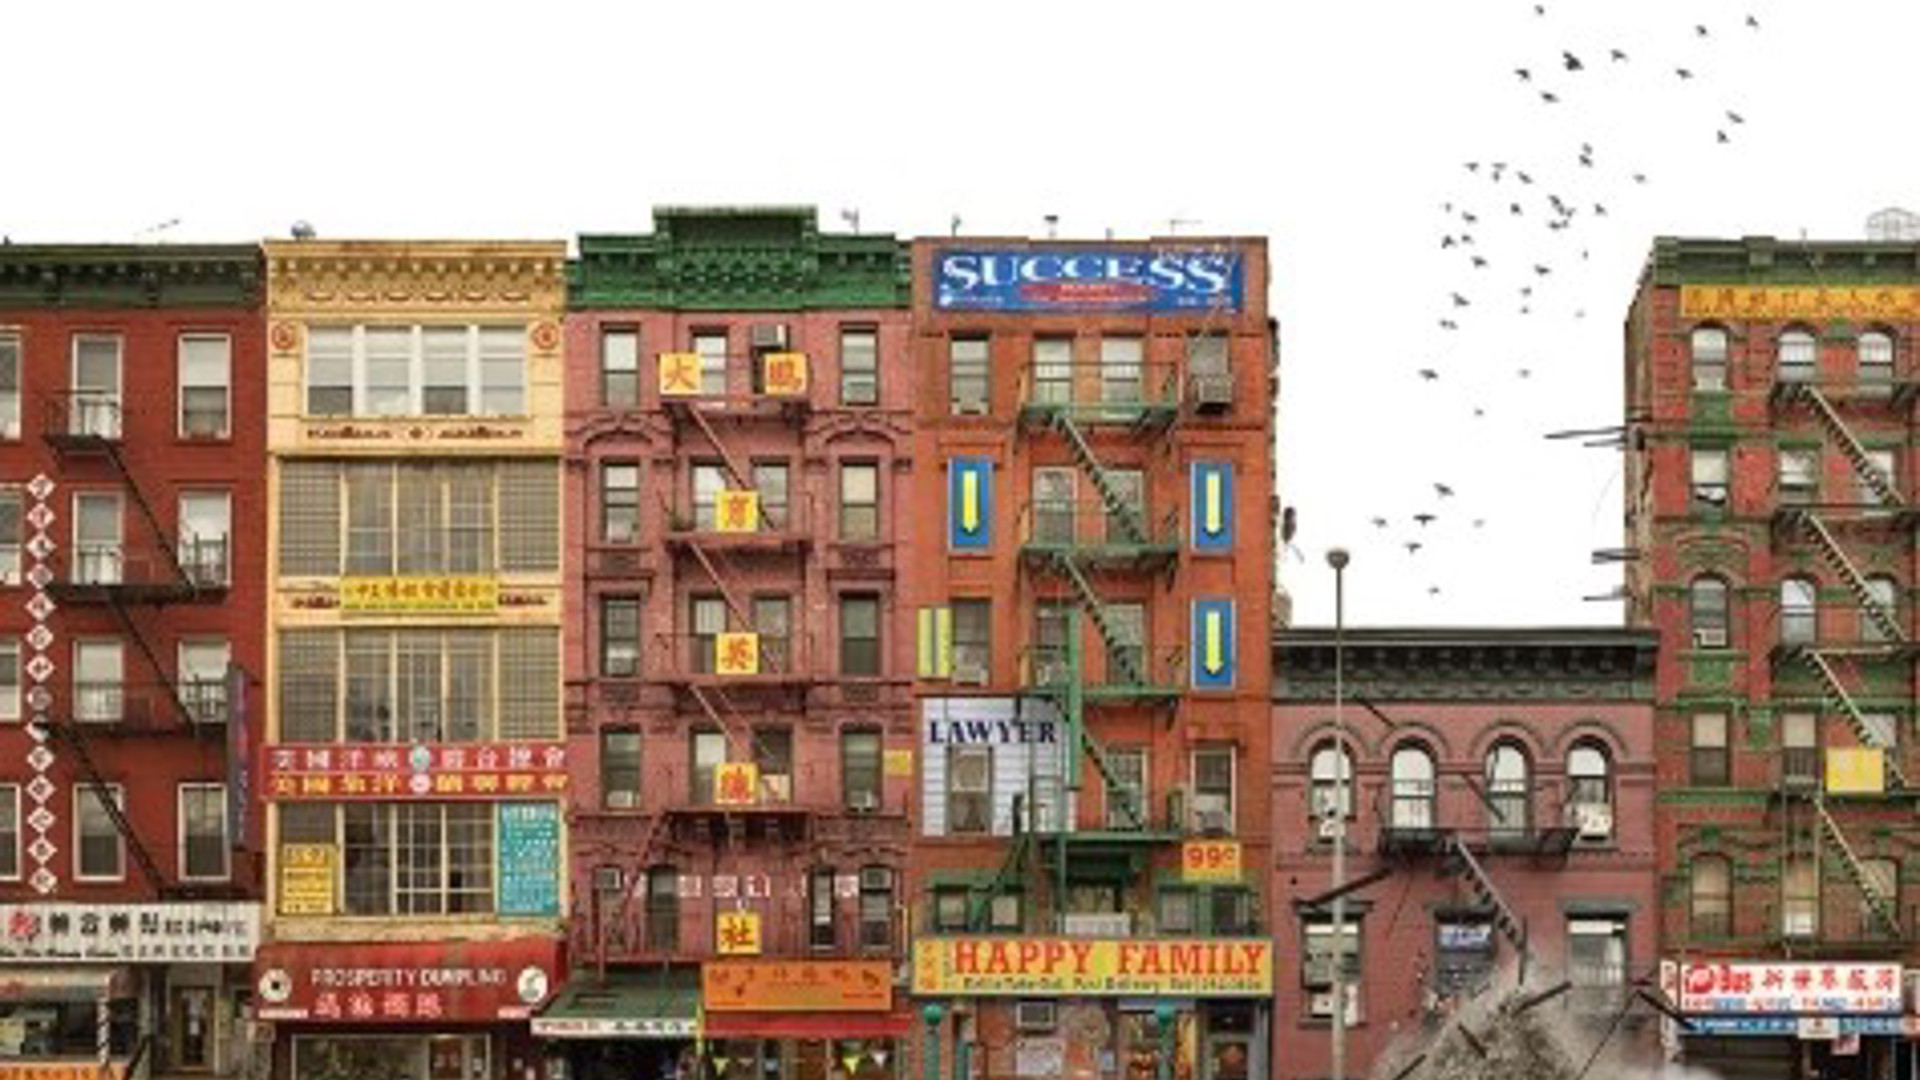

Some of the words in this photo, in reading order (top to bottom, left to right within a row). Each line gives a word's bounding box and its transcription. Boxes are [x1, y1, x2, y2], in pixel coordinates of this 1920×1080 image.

[942, 254, 1226, 293] SUCCESS
[665, 357, 696, 389] 大
[930, 721, 1057, 744] LAWYER
[955, 941, 1092, 974] HAPPY
[1118, 941, 1265, 974] FAMILY
[311, 968, 418, 986] PROSPERITY
[420, 968, 508, 986] DUMPLING
